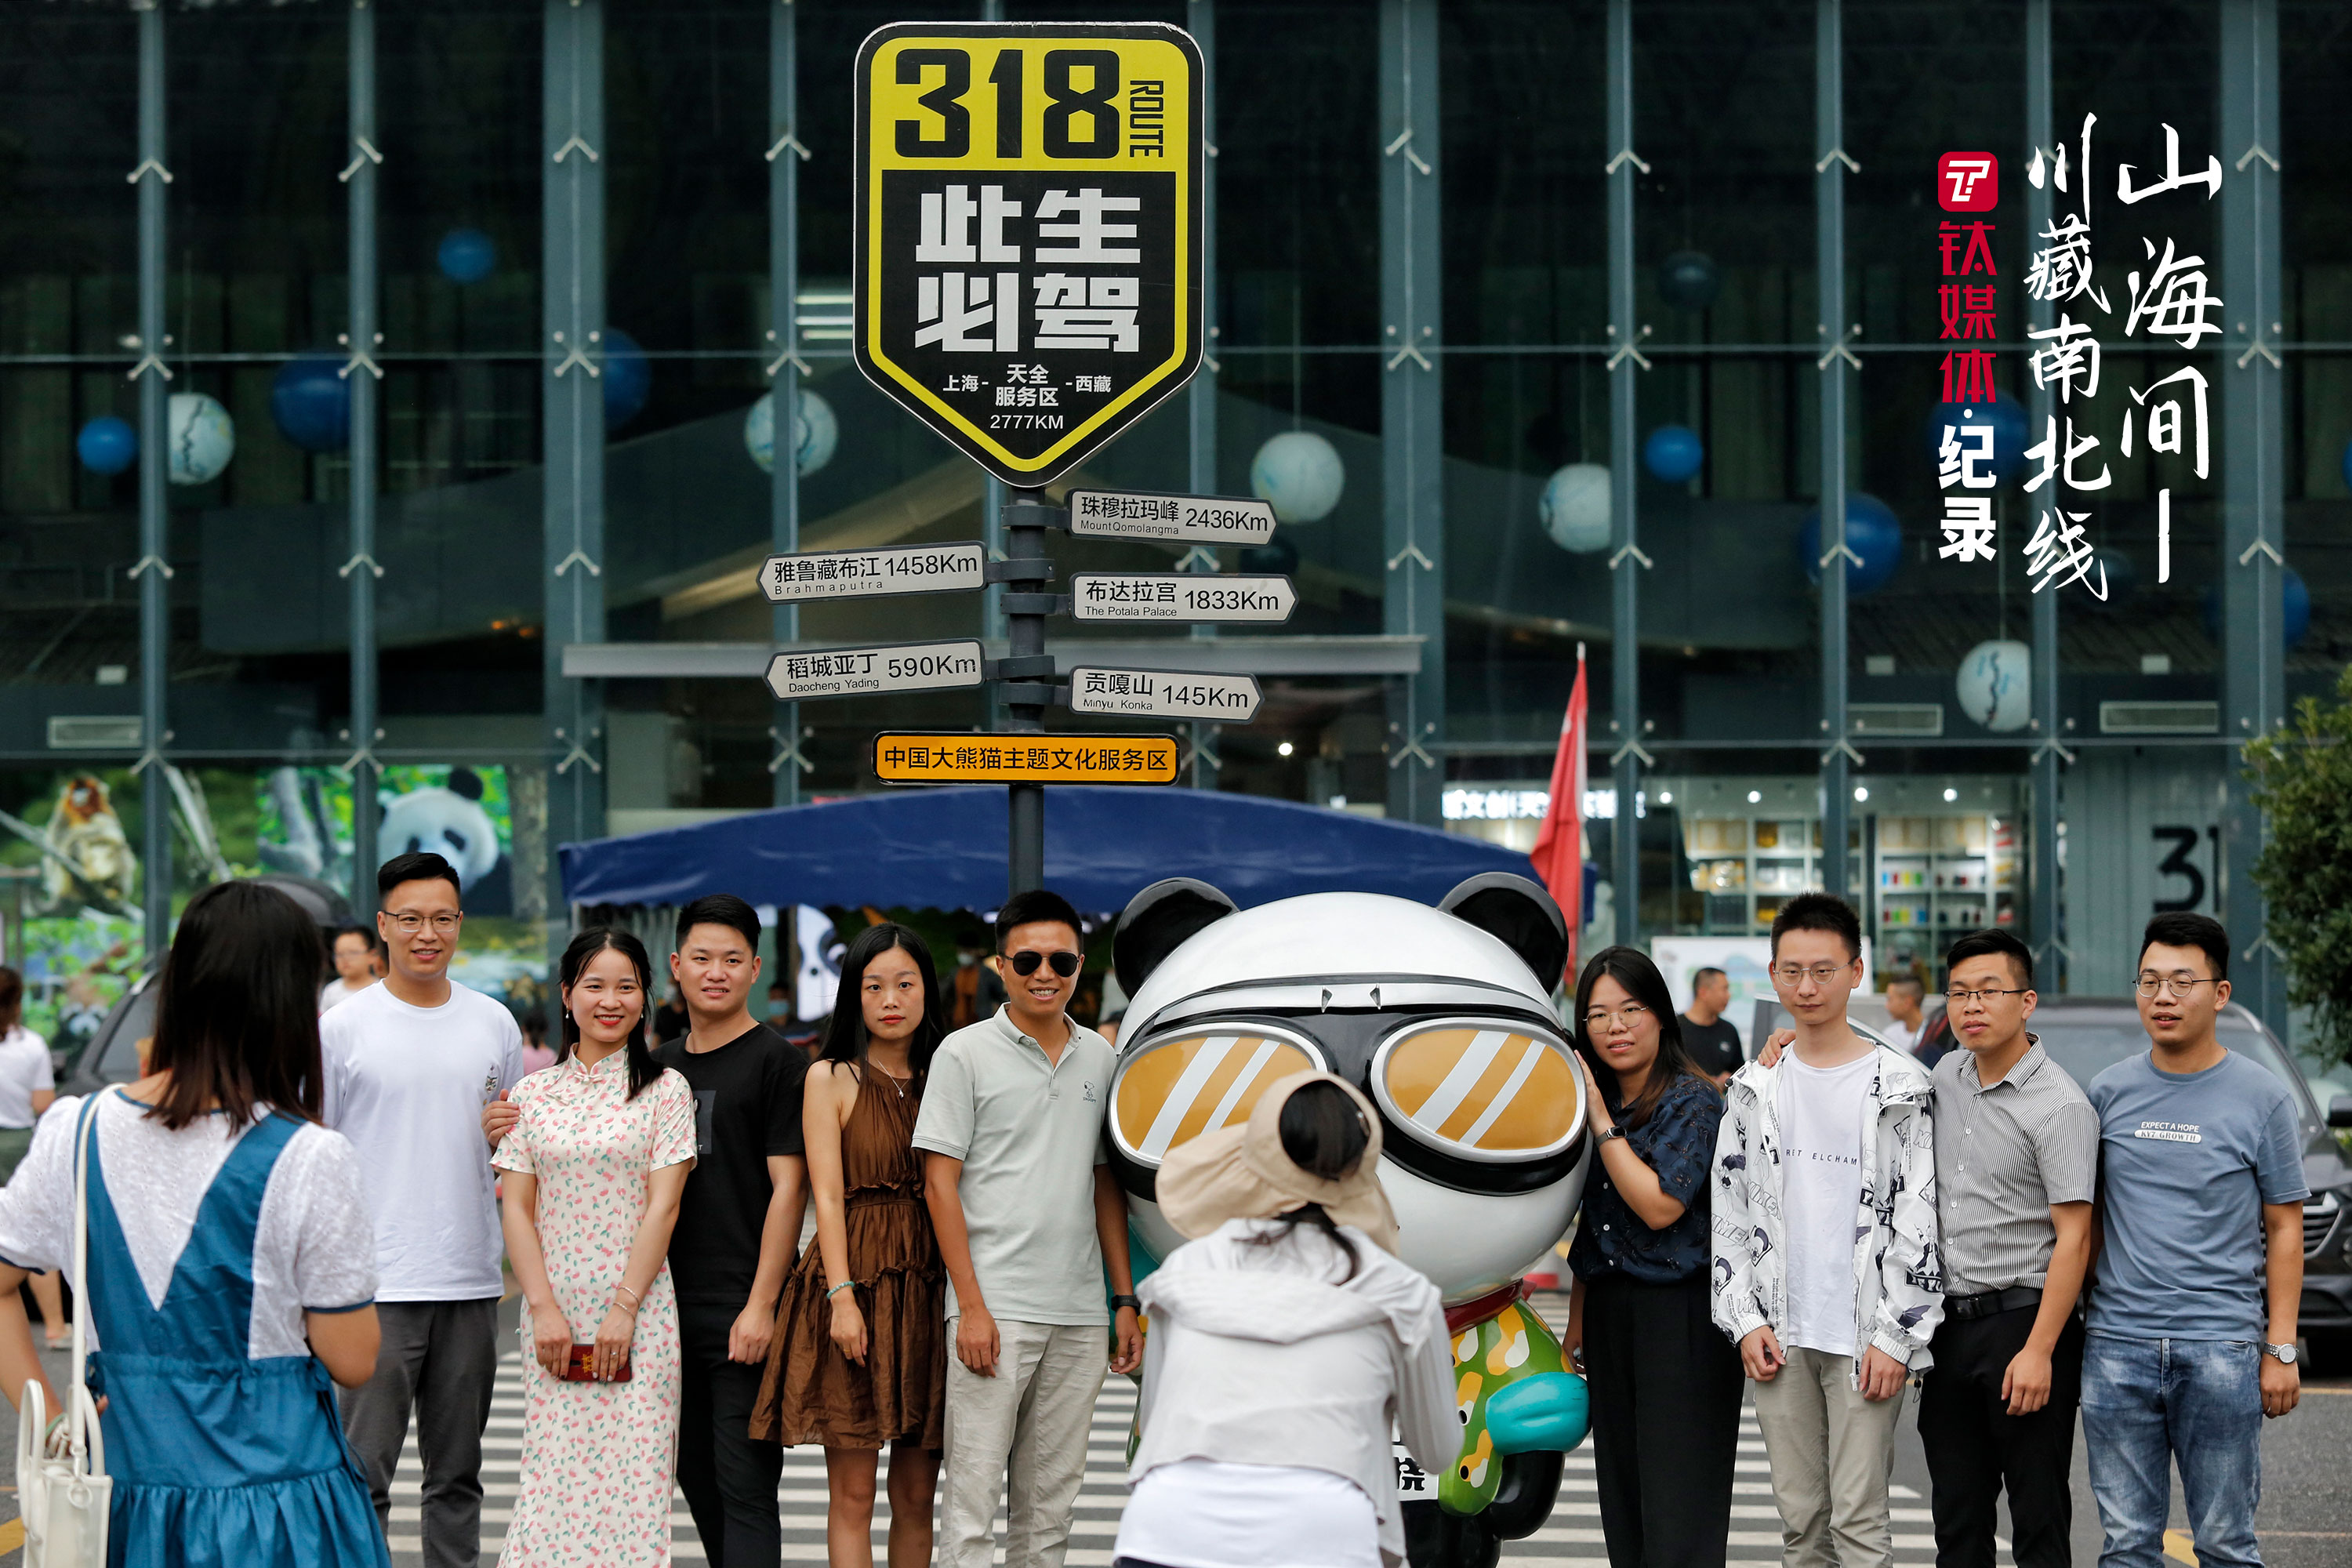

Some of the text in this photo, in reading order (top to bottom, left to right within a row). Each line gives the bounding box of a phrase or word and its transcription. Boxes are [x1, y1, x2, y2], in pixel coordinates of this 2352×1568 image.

[895, 48, 1120, 158] 318
[1129, 79, 1163, 158] ROUTE
[916, 184, 1141, 263] 此生
[915, 271, 1139, 353] 必驾
[1007, 364, 1049, 384] 天全
[995, 387, 1059, 408] 服务区
[989, 415, 1064, 430] 2777KM
[1081, 496, 1268, 532] 珠穆拉玛峰 2436Km
[775, 554, 978, 583] 雅鲁藏布江 1458Km
[775, 580, 883, 595] Brahmaputra
[1086, 580, 1279, 610] 布达拉宫 1833Km
[1085, 606, 1177, 617] The Potala Palace
[787, 653, 976, 680] 稻城亚丁 590Km
[789, 678, 880, 693] Daocheng Yading
[1085, 673, 1248, 708] 贡嘎山 145Km
[1083, 699, 1152, 710] Minyu Konka
[884, 746, 1169, 771] 中国大熊猫主题文化服务区
[2141, 1121, 2169, 1130] EXPECT
[2177, 1123, 2199, 1132] HOPE
[2159, 1131, 2196, 1142] GROWTH
